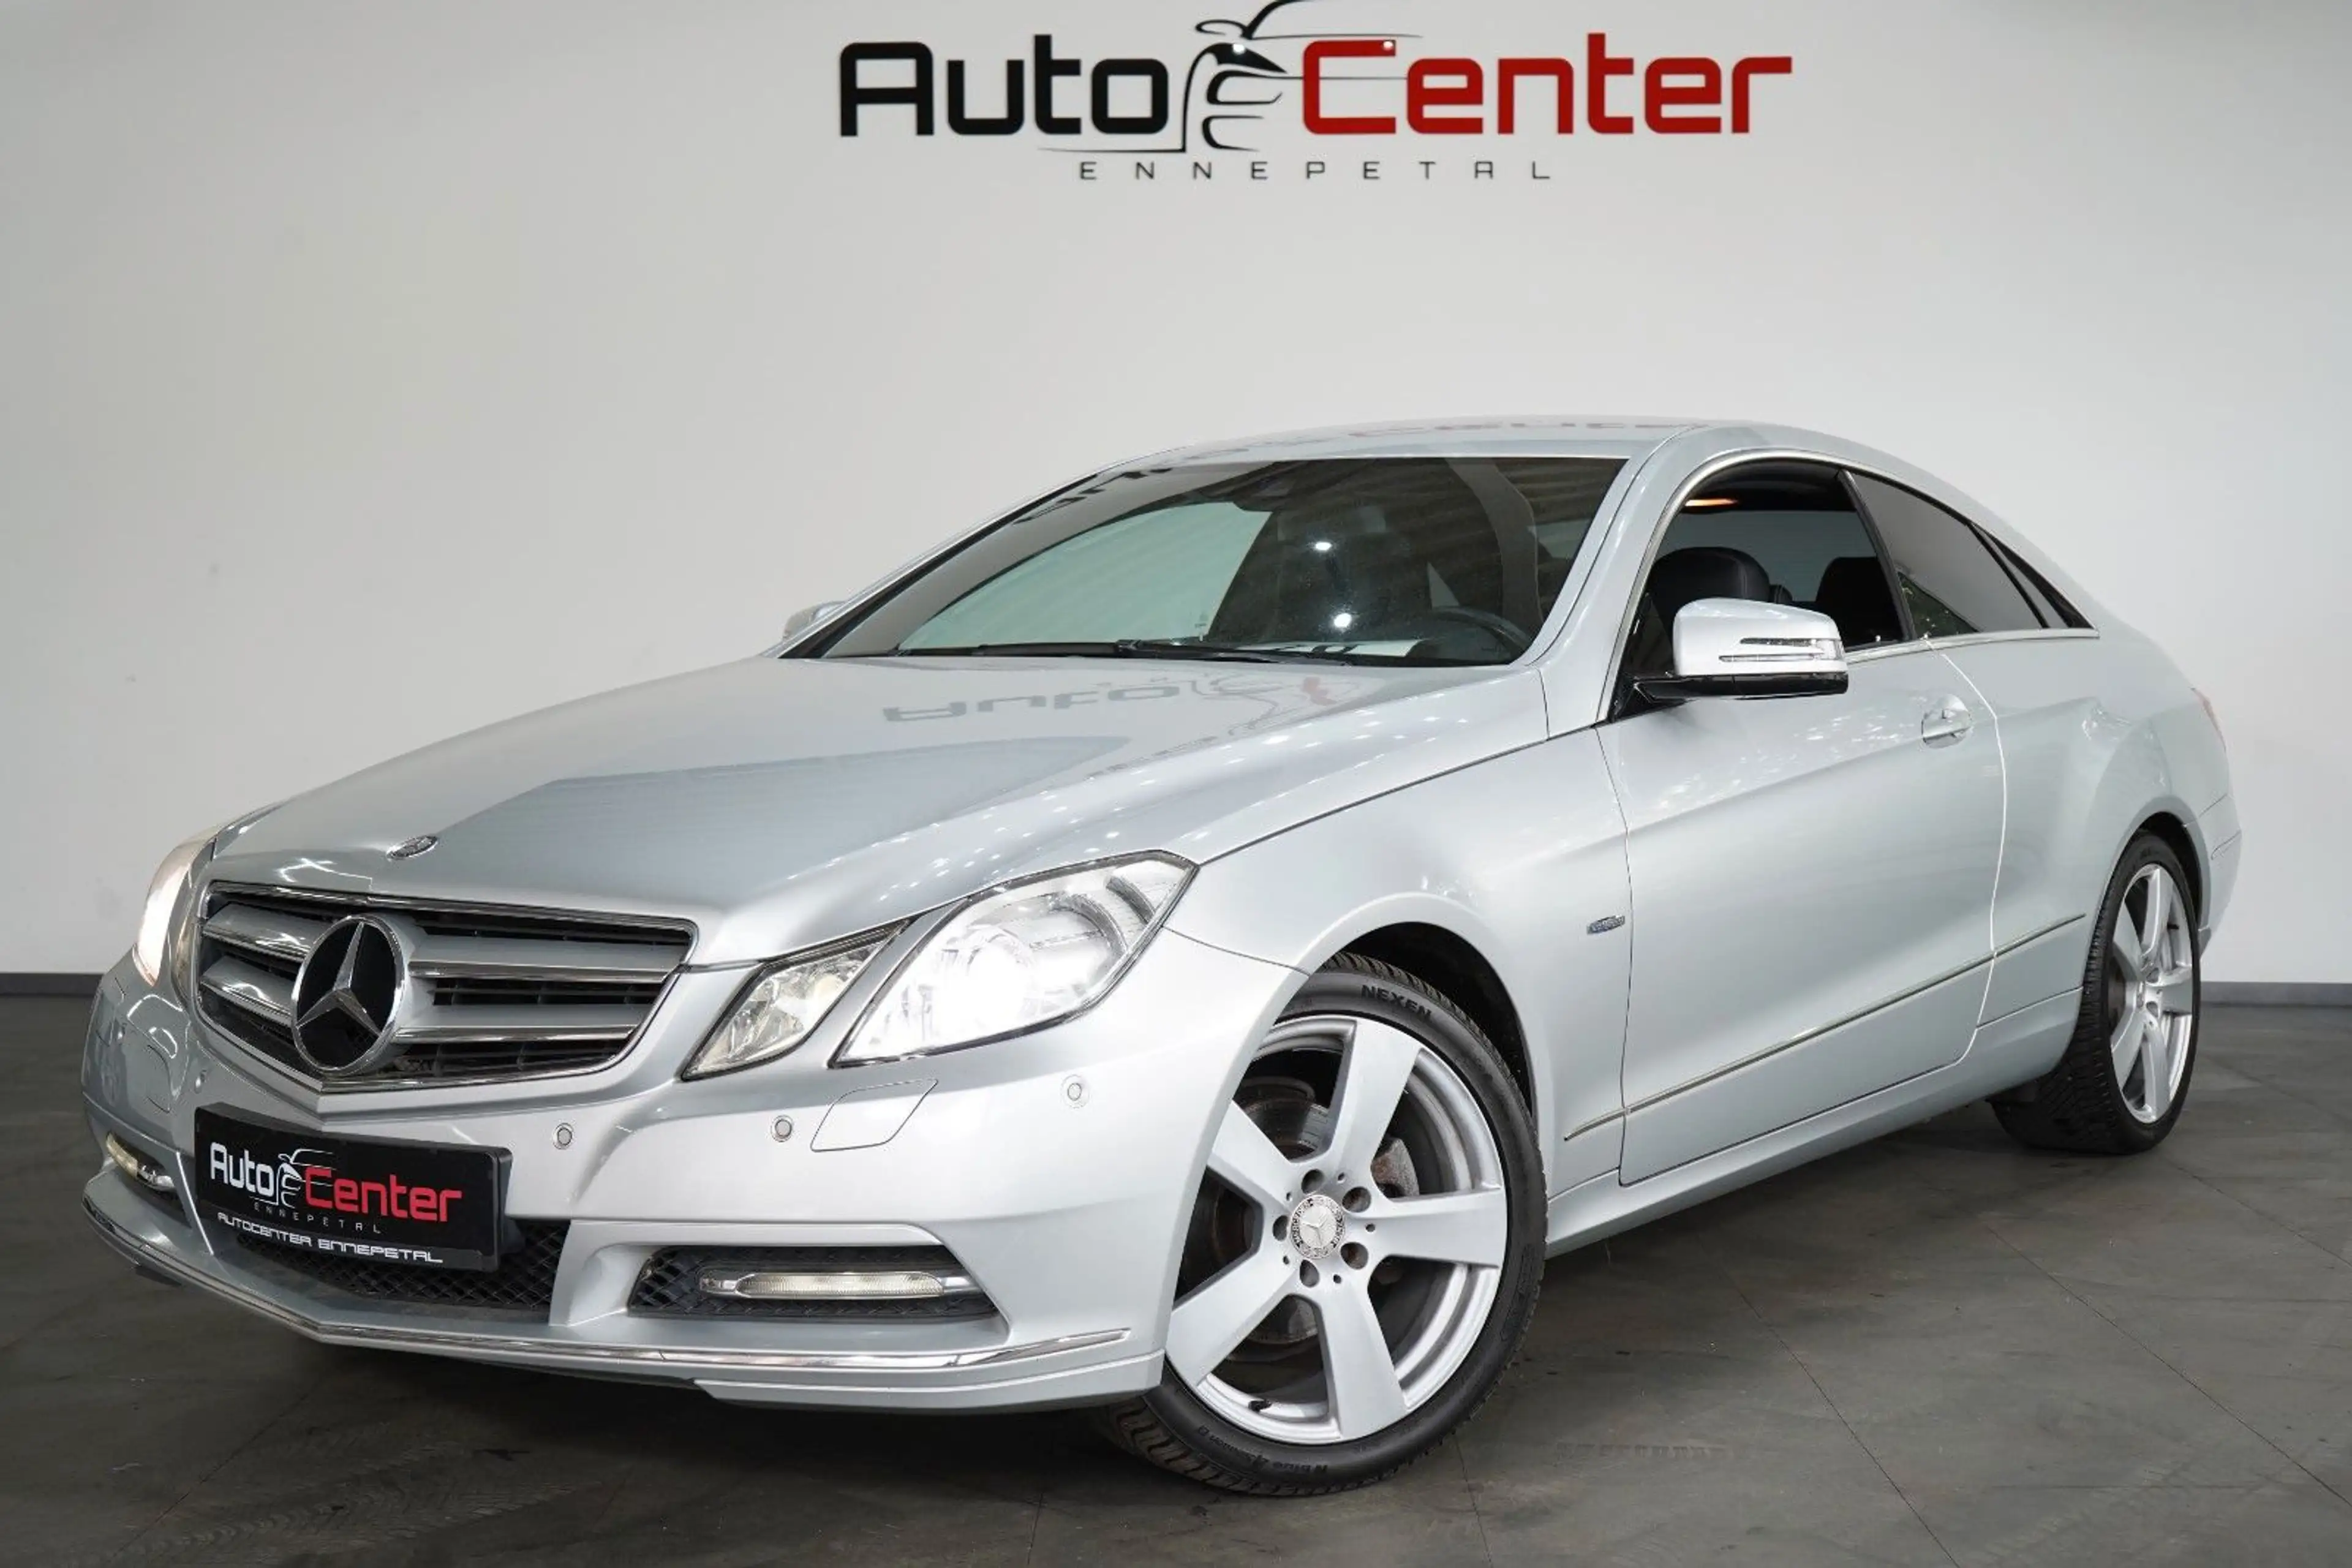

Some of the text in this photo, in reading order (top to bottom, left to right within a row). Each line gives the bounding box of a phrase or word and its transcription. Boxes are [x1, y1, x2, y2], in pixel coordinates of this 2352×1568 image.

[840, 33, 1793, 137] Auto Center
[1080, 162, 1550, 180] ENNEPETAL
[1362, 984, 1432, 1018] NEXEN
[210, 1142, 462, 1221] Auto Center
[217, 1212, 443, 1264] AUTOCENTER ENNEPETAL
[254, 1202, 381, 1234] ENNEPETAL
